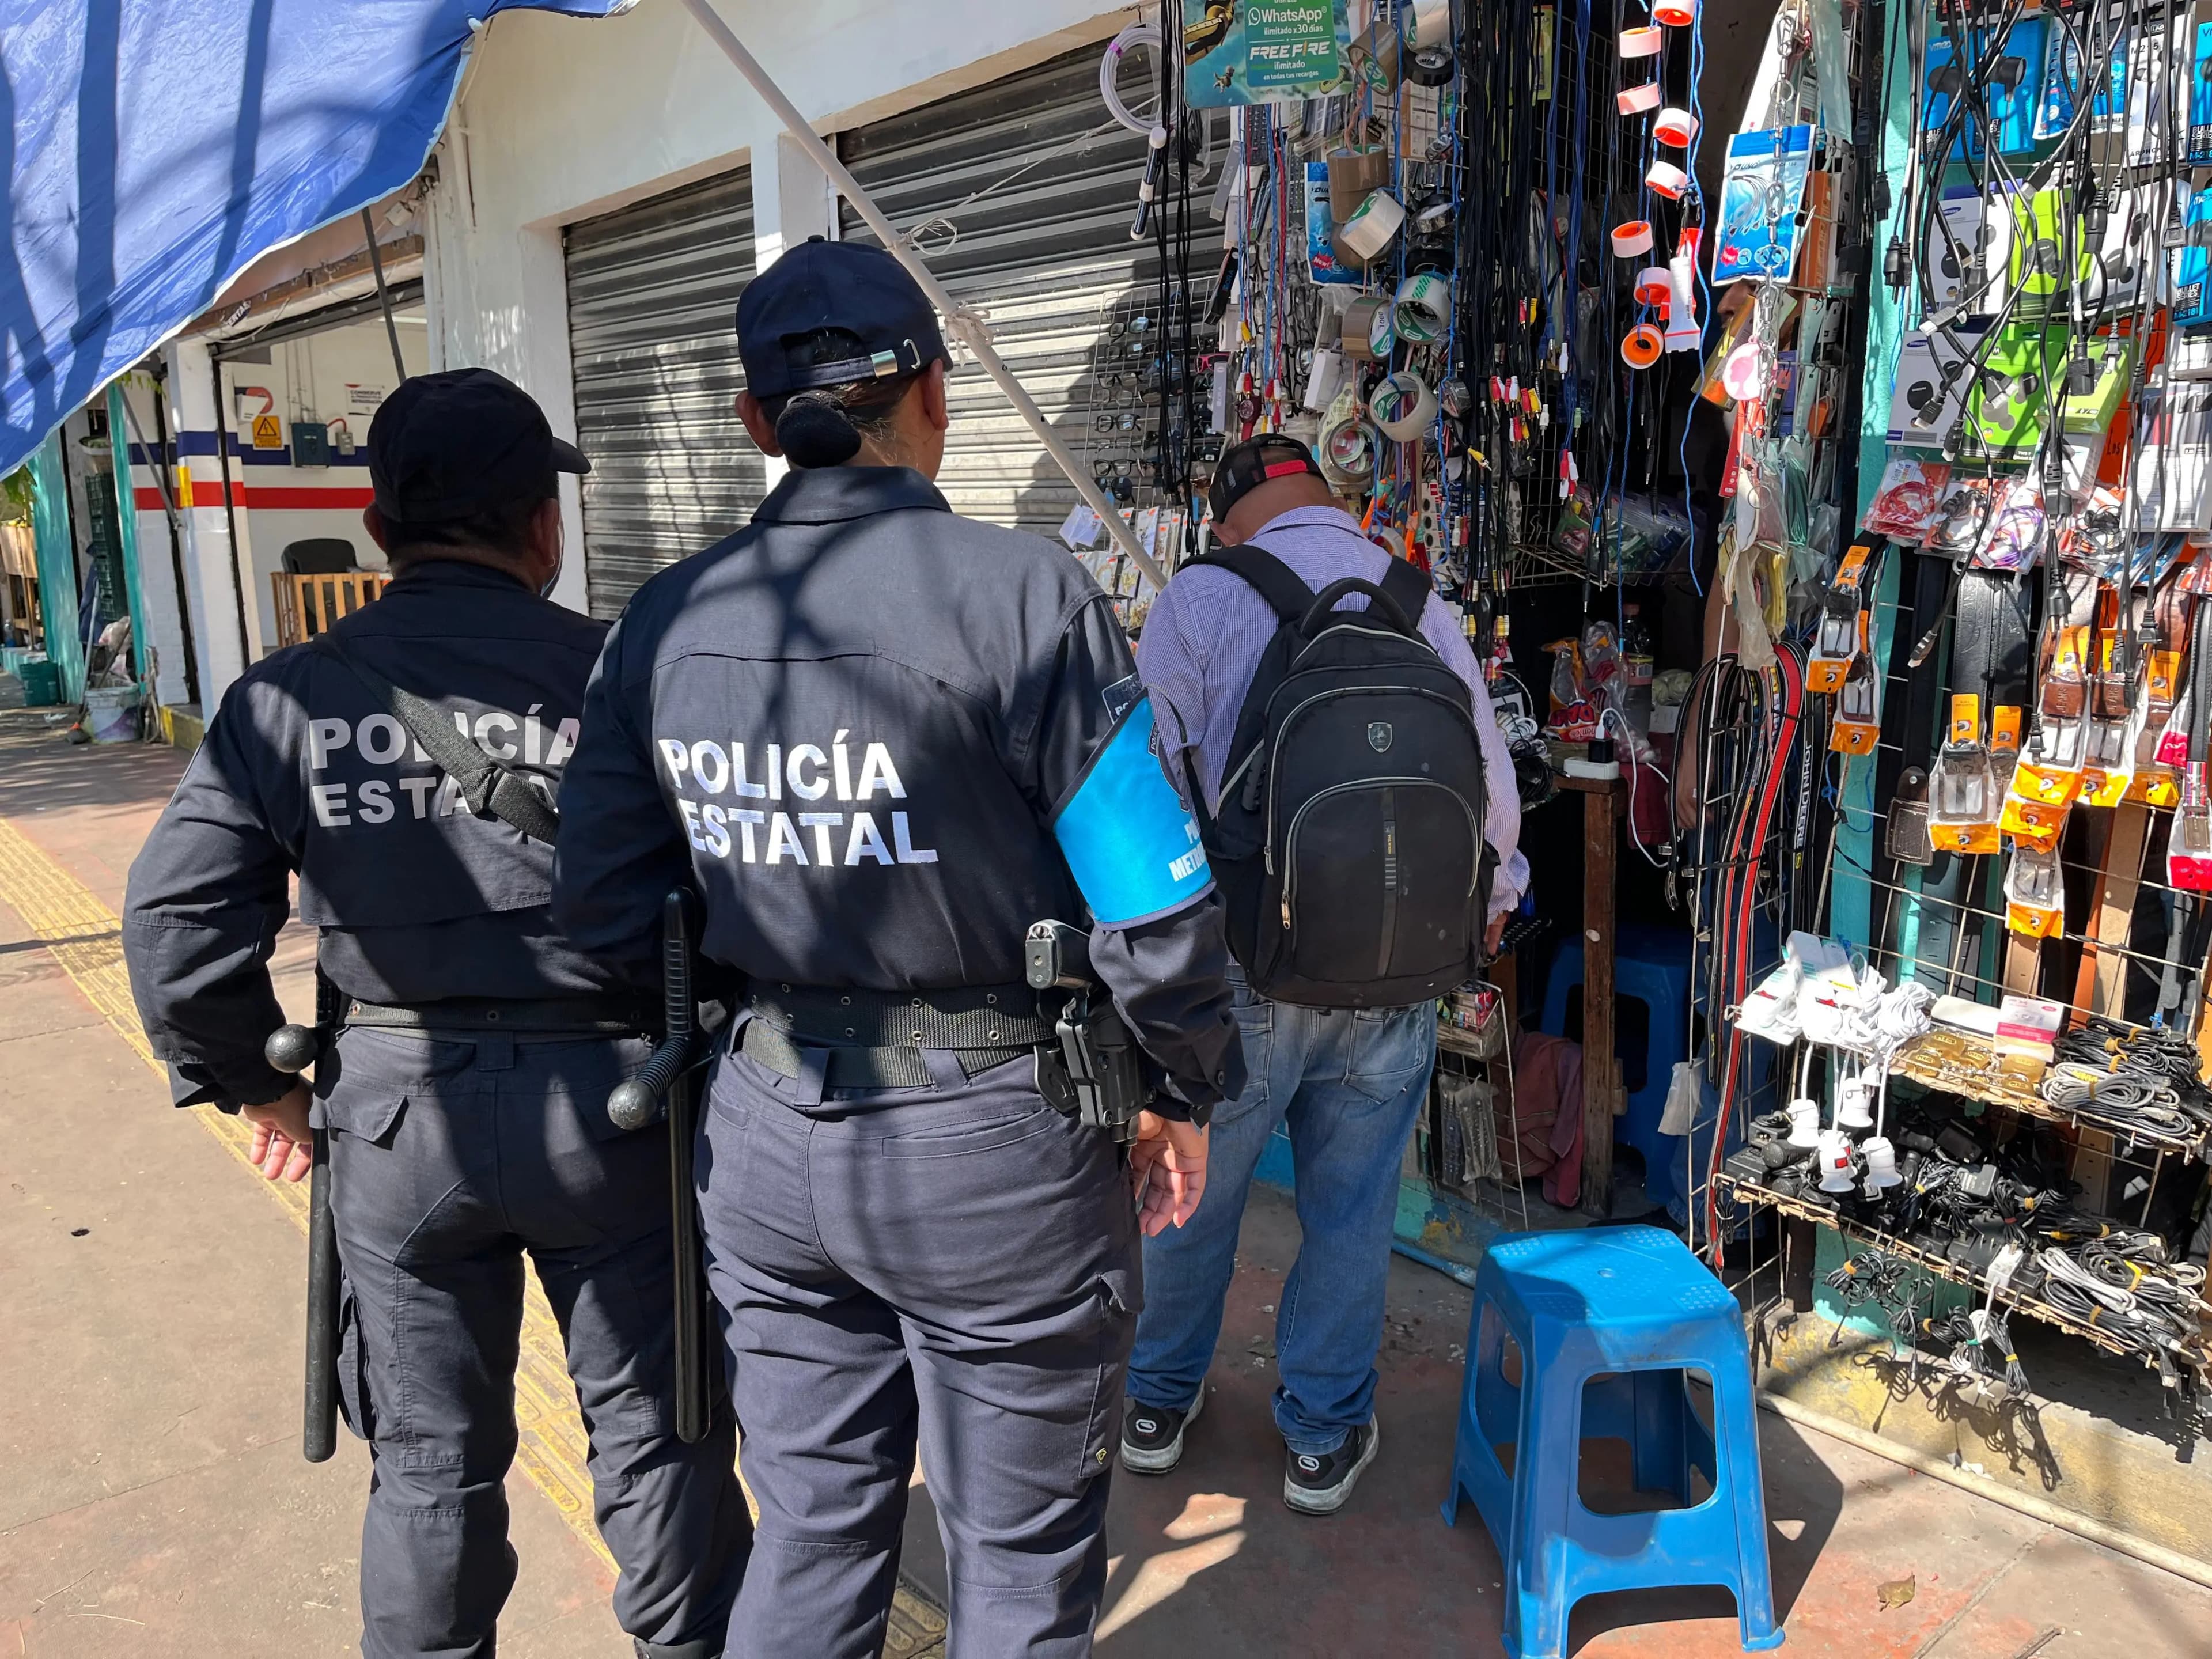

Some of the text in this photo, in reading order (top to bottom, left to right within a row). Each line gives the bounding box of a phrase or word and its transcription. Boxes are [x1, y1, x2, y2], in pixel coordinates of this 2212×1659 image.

[1264, 26, 1292, 35] ilimitado
[1309, 24, 1323, 32] días
[1249, 40, 1330, 60] FREE FIRE
[1274, 60, 1305, 70] ilimitado
[1313, 256, 1331, 268] New!
[2056, 687, 2068, 713] JEANS
[658, 729, 908, 801] POLICÍA
[1796, 740, 1812, 849] JOHN DEERE
[677, 798, 939, 867] ESTATAL
